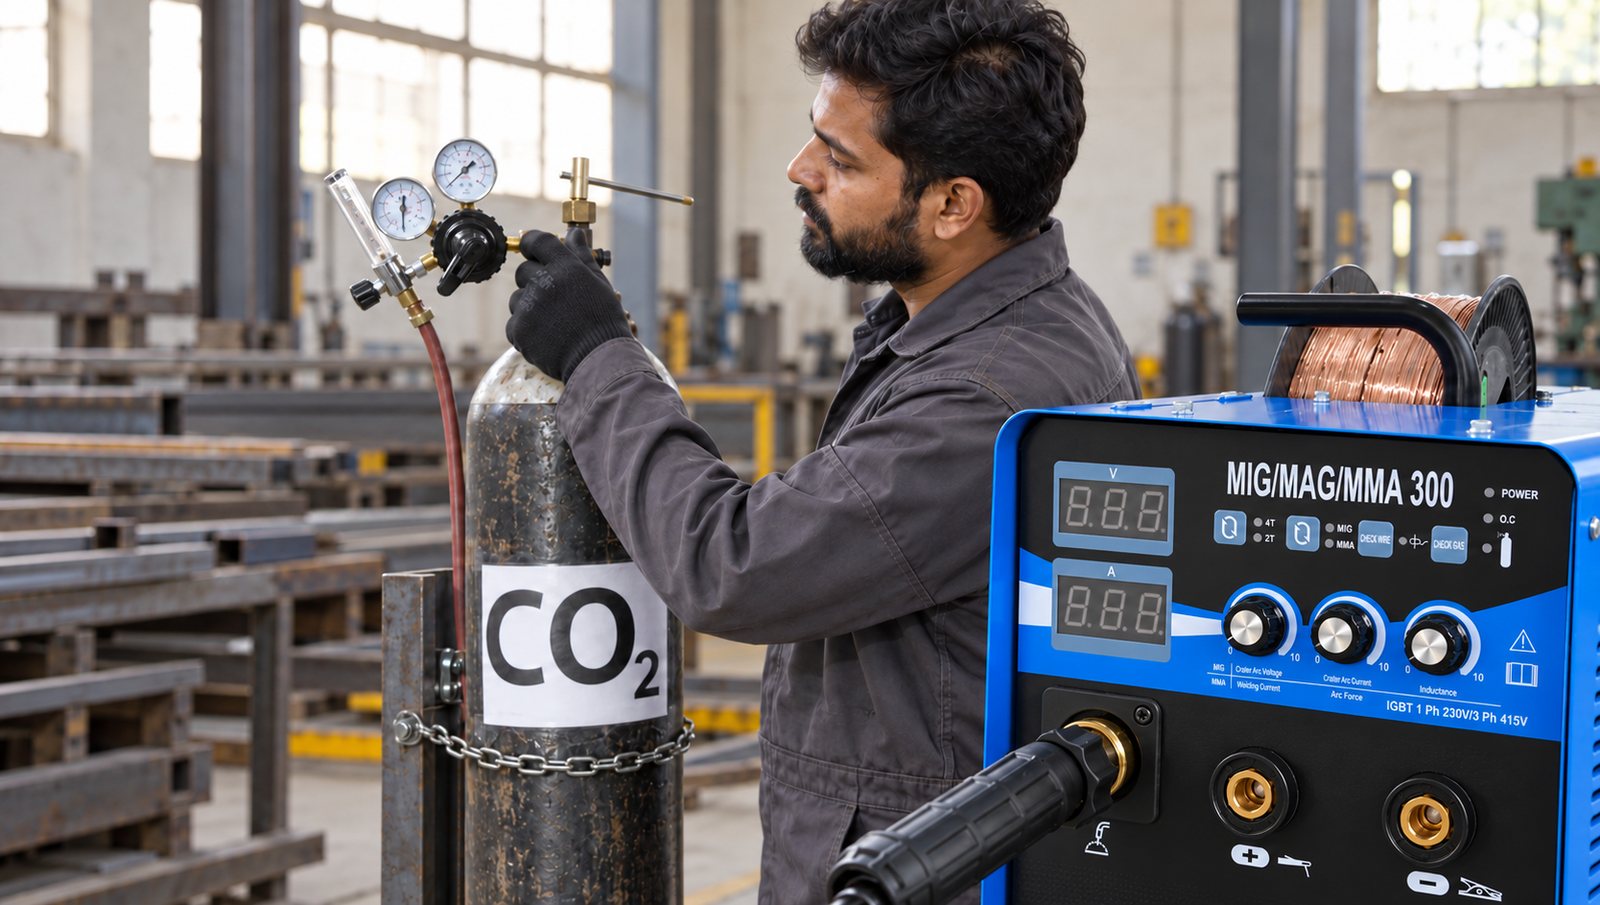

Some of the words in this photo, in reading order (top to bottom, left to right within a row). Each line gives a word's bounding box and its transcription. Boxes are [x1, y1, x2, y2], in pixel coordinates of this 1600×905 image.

[1109, 468, 1118, 479] V
[1227, 461, 1404, 505] MIG/MAG/MMA
[1410, 470, 1454, 508] 300
[1501, 488, 1539, 500] POWER
[1264, 518, 1276, 527] 4T
[1499, 514, 1516, 524] O.C
[1336, 524, 1353, 533] MIG
[1264, 534, 1276, 543] 2T
[1336, 540, 1355, 550] MMA
[1107, 565, 1116, 577] A
[486, 587, 660, 700] CO2
[1227, 646, 1233, 655] 0
[1290, 653, 1300, 662] 10
[1314, 655, 1320, 664] 0
[1378, 662, 1389, 671] 10
[1405, 665, 1411, 674] 0
[1473, 672, 1484, 682] 10
[1330, 691, 1343, 699] Arc
[1344, 691, 1363, 701] Force
[1419, 685, 1457, 697] Inductance
[1386, 700, 1413, 713] IGBT
[1416, 703, 1422, 714] 1
[1425, 704, 1440, 716] Ph
[1442, 707, 1479, 721] 230V/3
[1482, 711, 1497, 724] Ph
[1500, 714, 1528, 727] 415V
